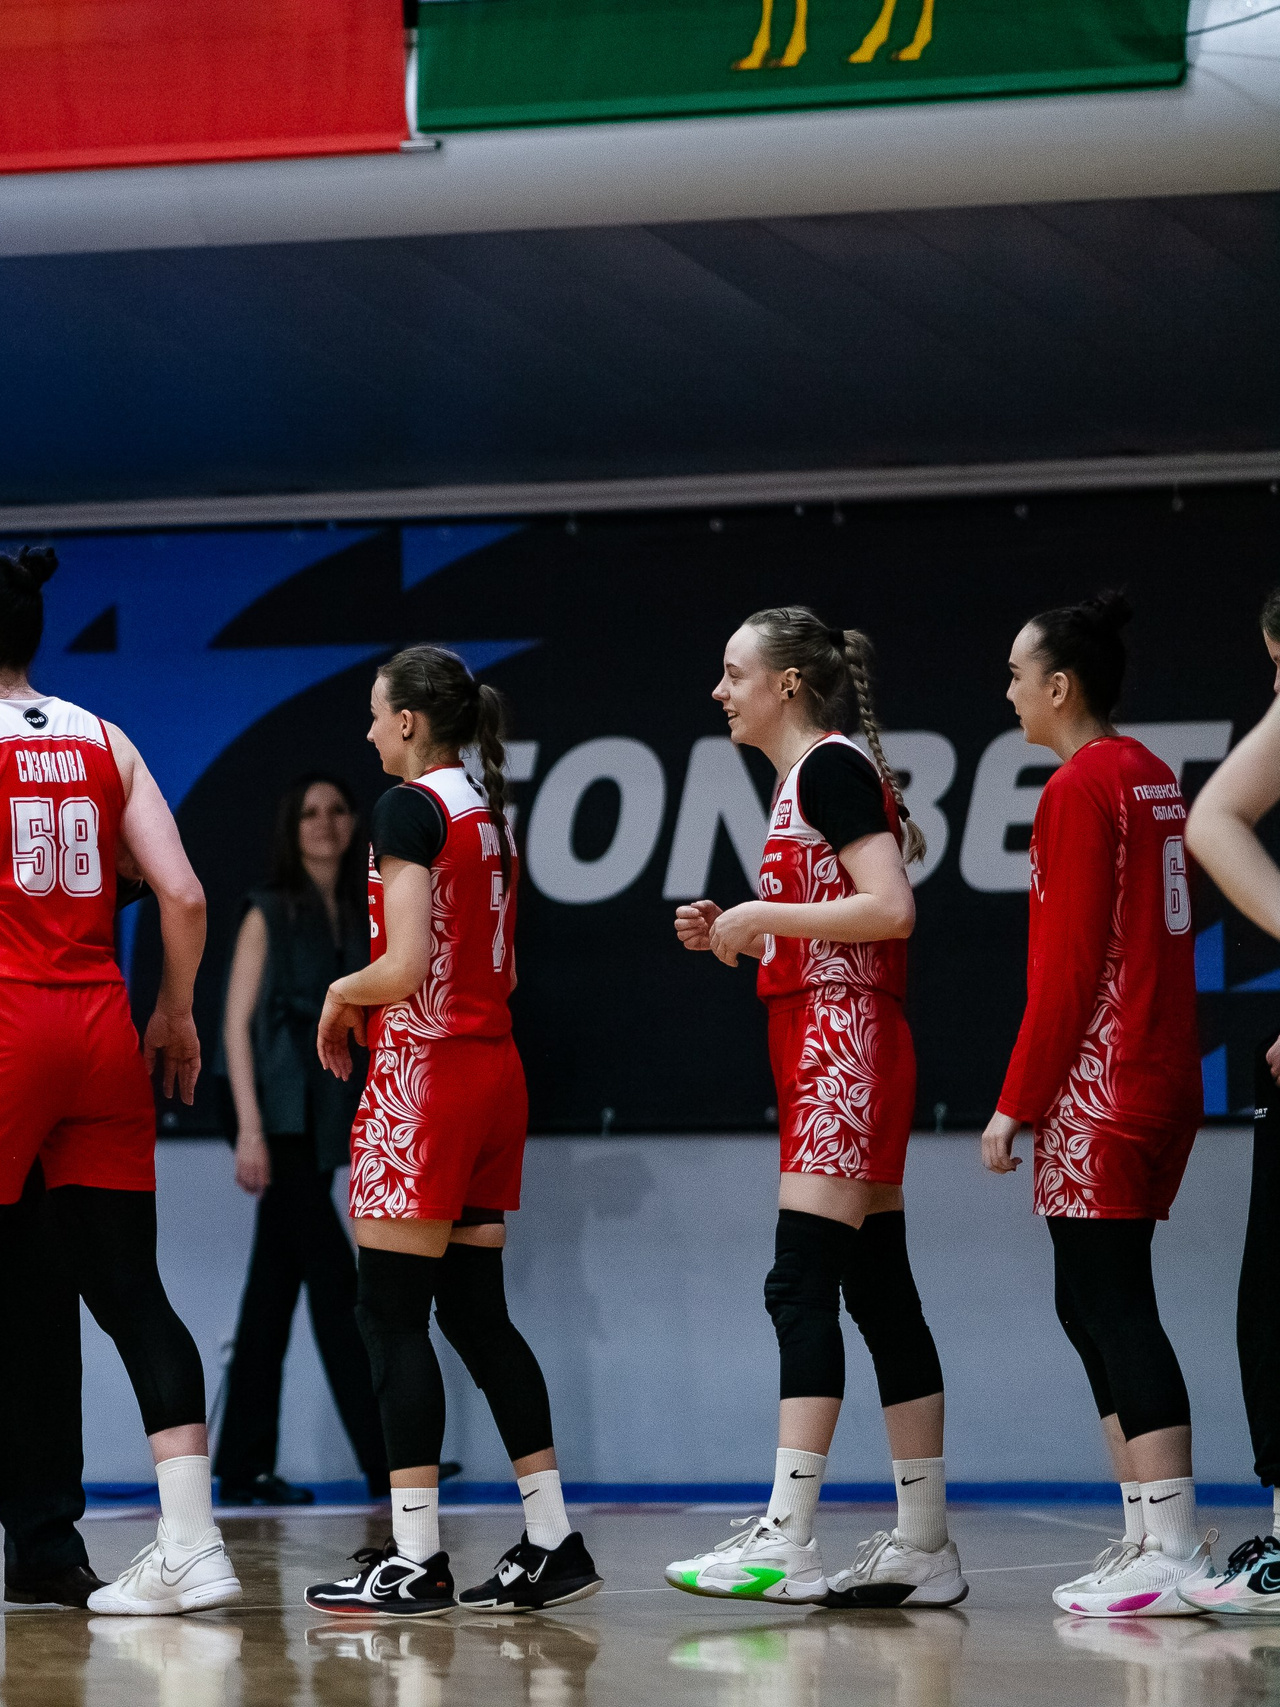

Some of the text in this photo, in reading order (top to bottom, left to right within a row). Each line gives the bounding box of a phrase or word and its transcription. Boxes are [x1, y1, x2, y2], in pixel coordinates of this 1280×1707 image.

[1132, 783, 1183, 801] ПЕНЗЕНСКА
[1152, 804, 1187, 821] ОБЛАСТЬ
[9, 796, 103, 898] 58
[1162, 835, 1192, 935] 6
[490, 870, 510, 973] 7
